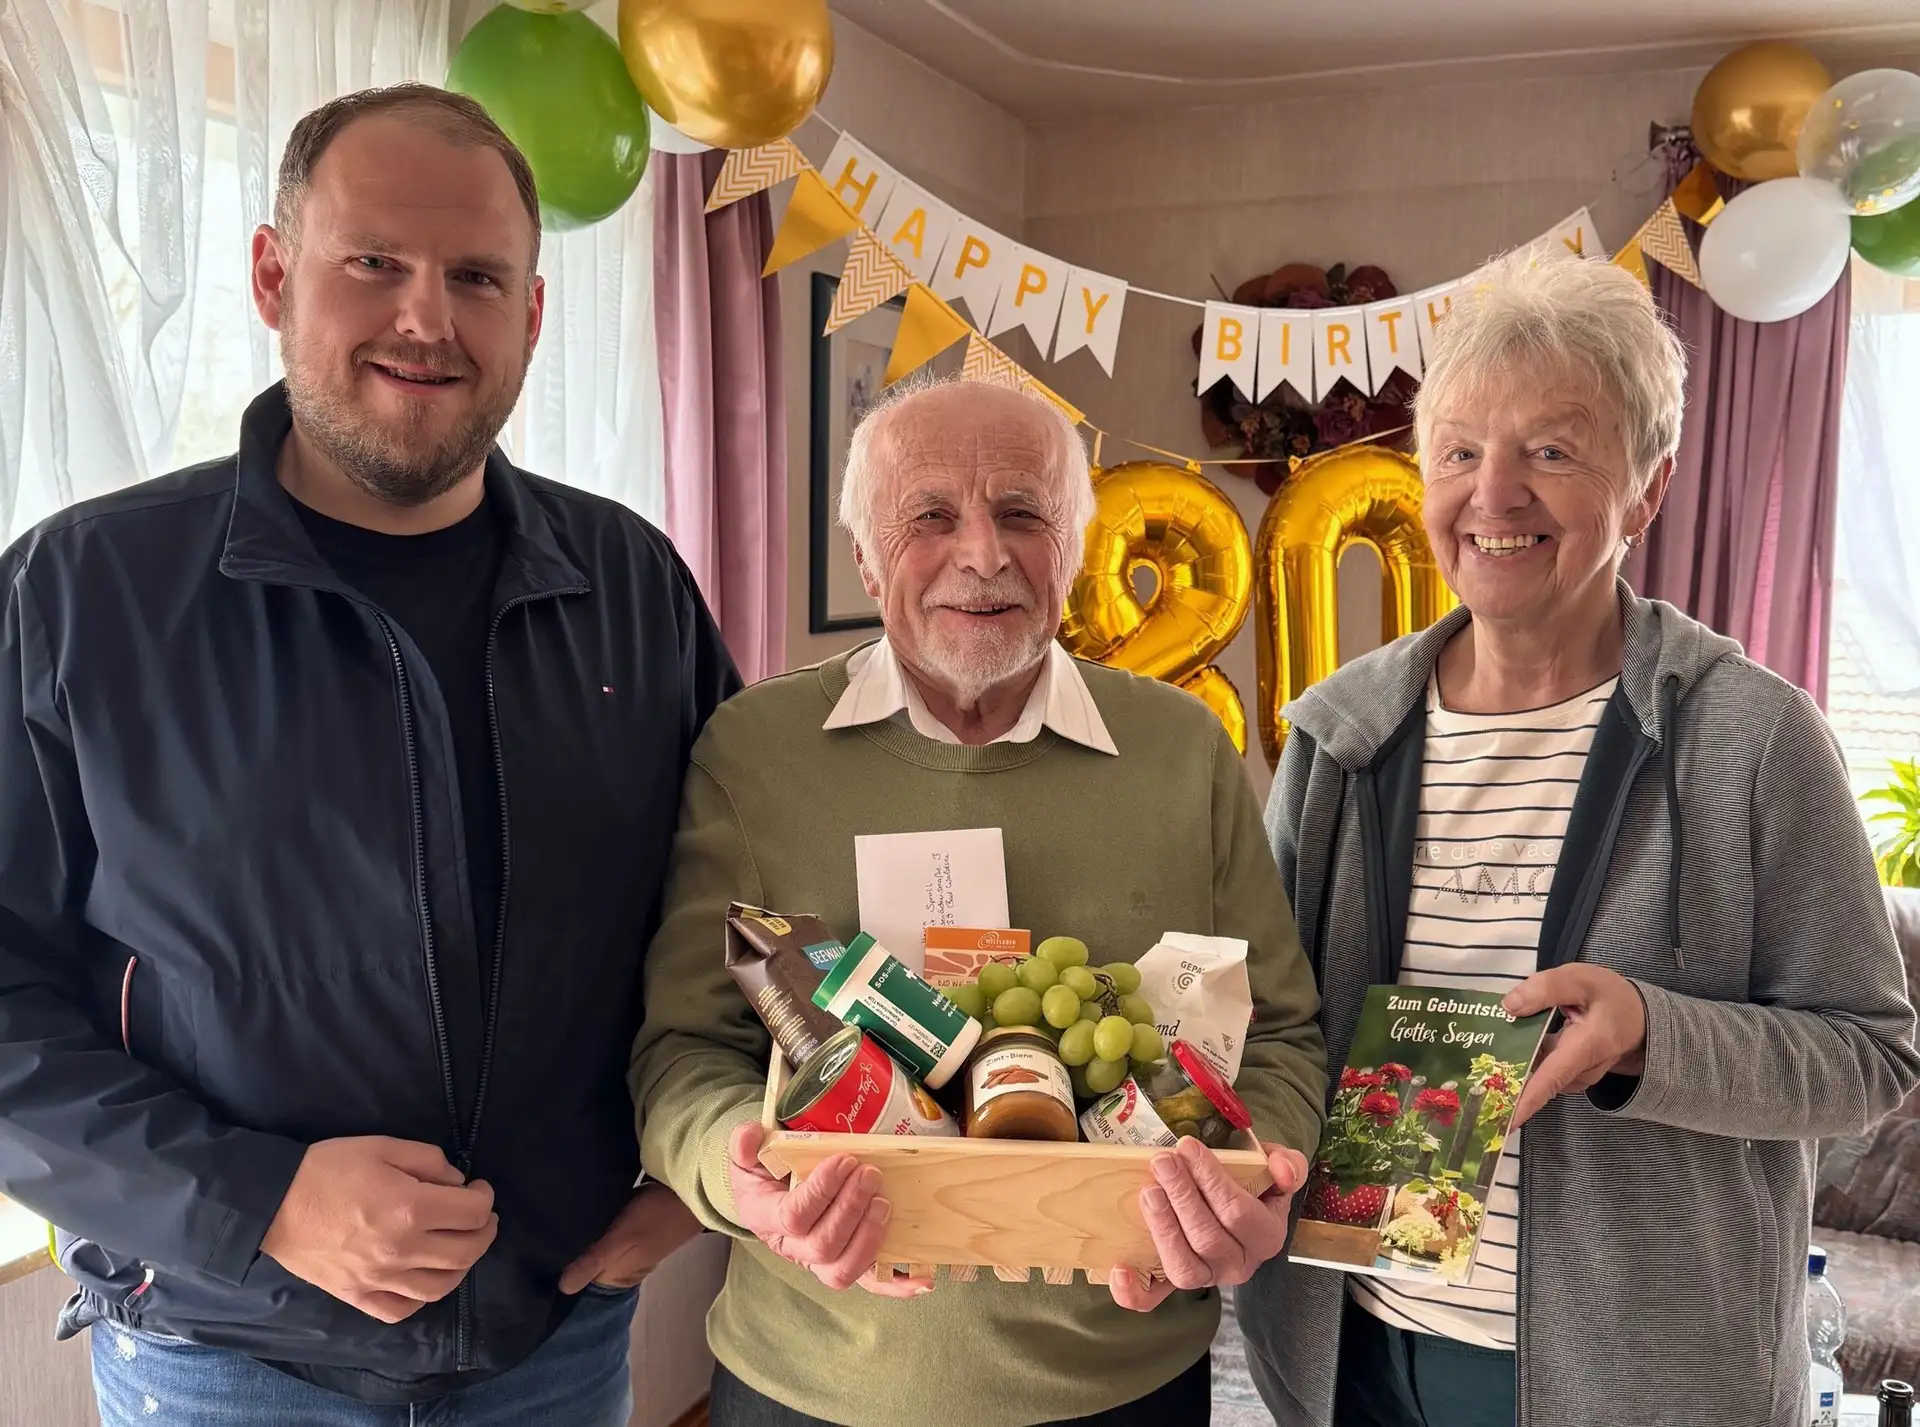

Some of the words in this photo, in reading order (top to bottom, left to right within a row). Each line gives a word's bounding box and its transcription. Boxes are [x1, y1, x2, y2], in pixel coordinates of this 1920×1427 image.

[833, 157, 1110, 335] HAPPY
[1216, 226, 1584, 366] BIRTHY
[1387, 995, 1422, 1011] Zum
[1390, 1016, 1438, 1043] Gottes
[1442, 1021, 1495, 1049] Segen
[835, 1093, 866, 1134] Jeden
[858, 1073, 880, 1095] Tag
